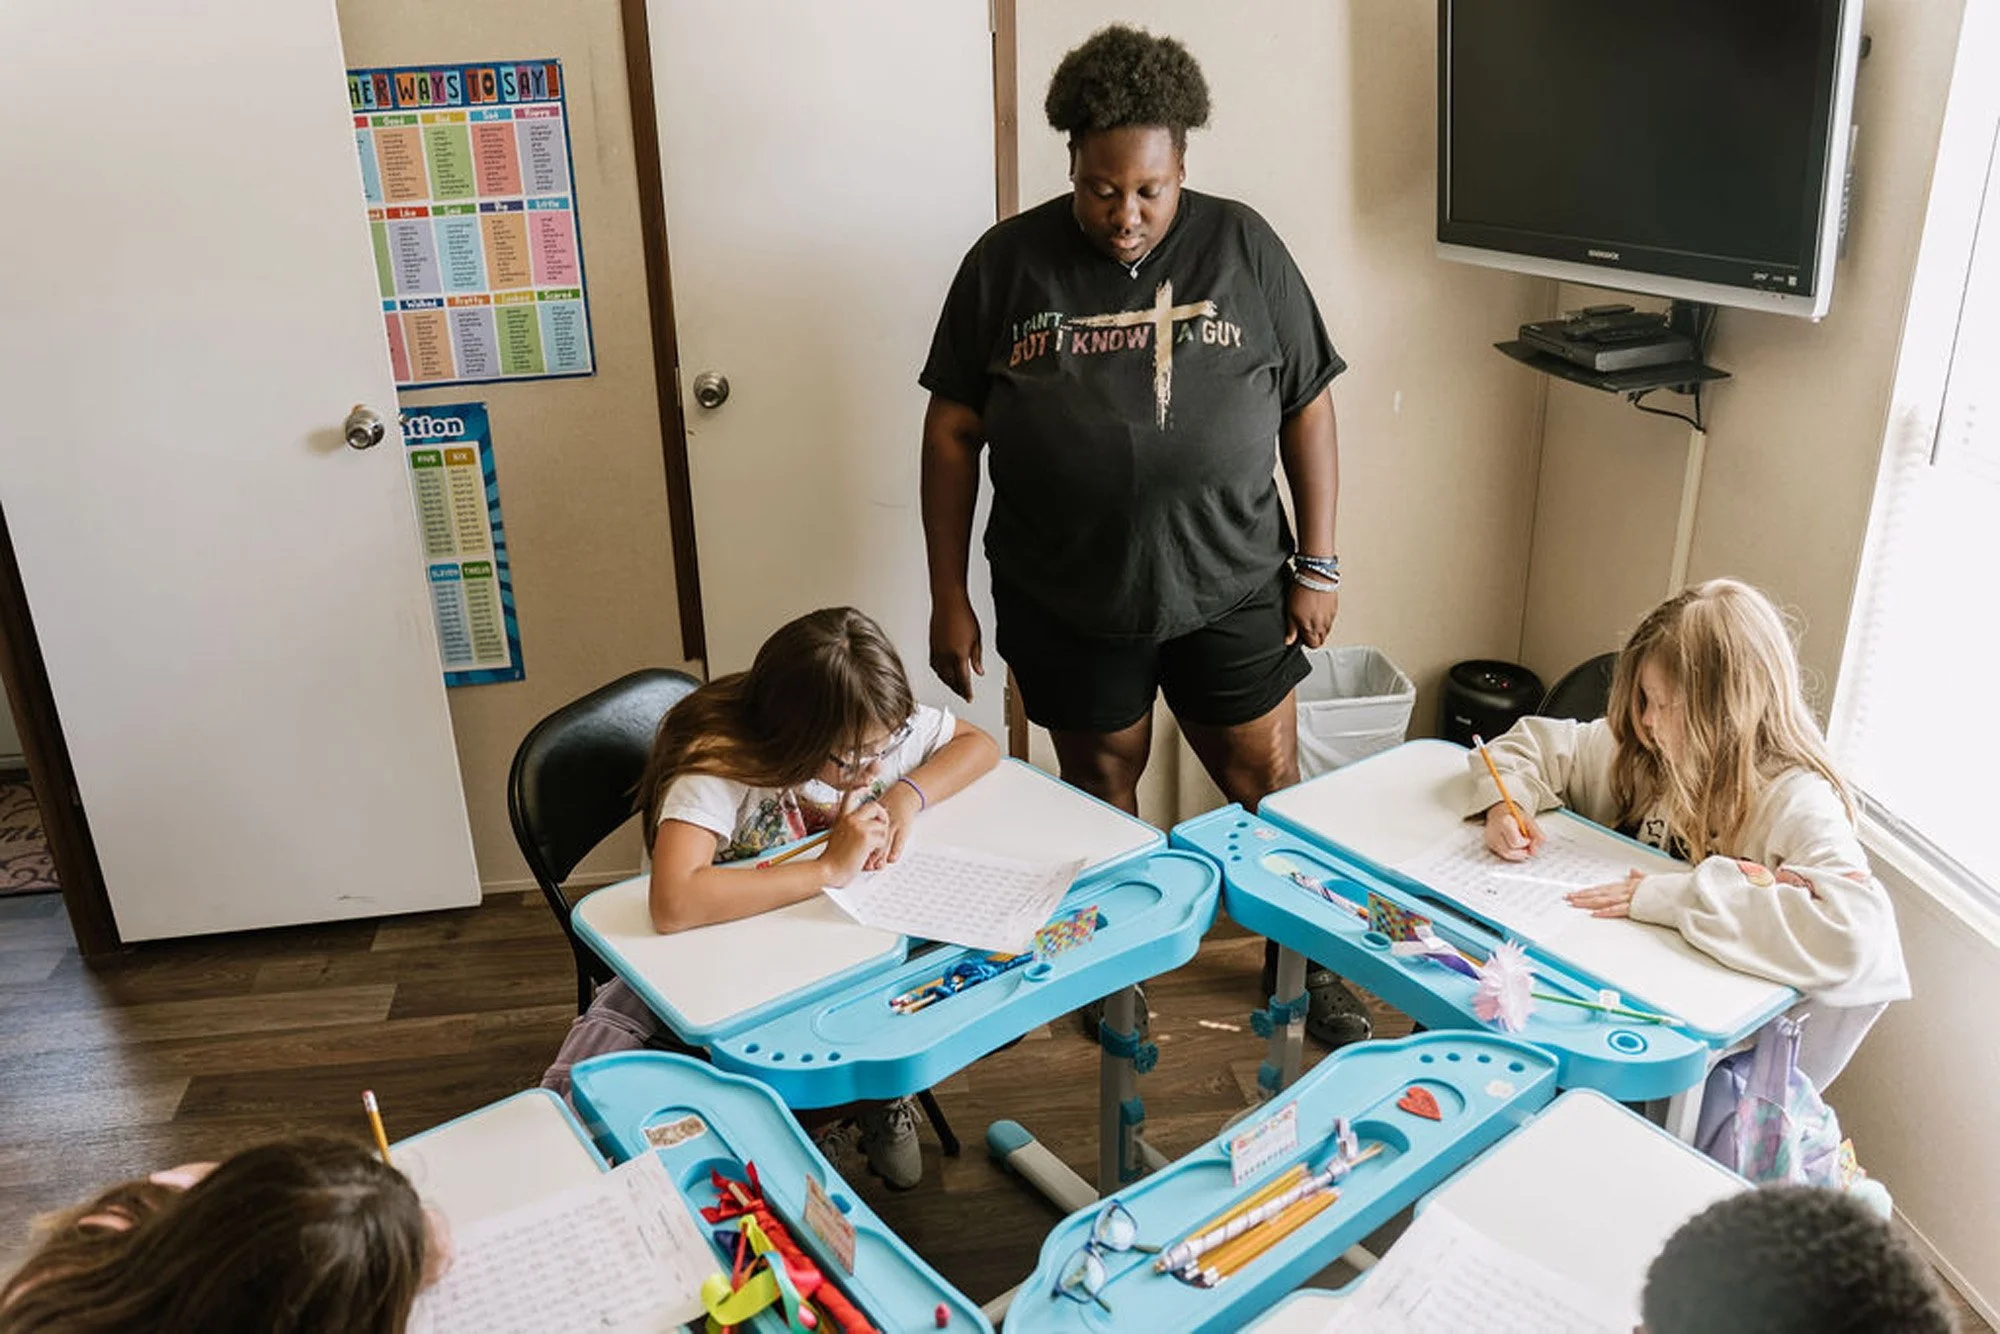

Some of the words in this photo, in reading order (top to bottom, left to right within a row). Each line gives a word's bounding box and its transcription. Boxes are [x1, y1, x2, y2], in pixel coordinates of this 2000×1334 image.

[397, 75, 460, 101] WAYS
[467, 72, 495, 98] TO
[1009, 330, 1050, 367] BUT
[1072, 325, 1151, 354] KNOW
[1176, 322, 1194, 343] A
[1202, 320, 1241, 347] GUY
[1012, 323, 1018, 341] I
